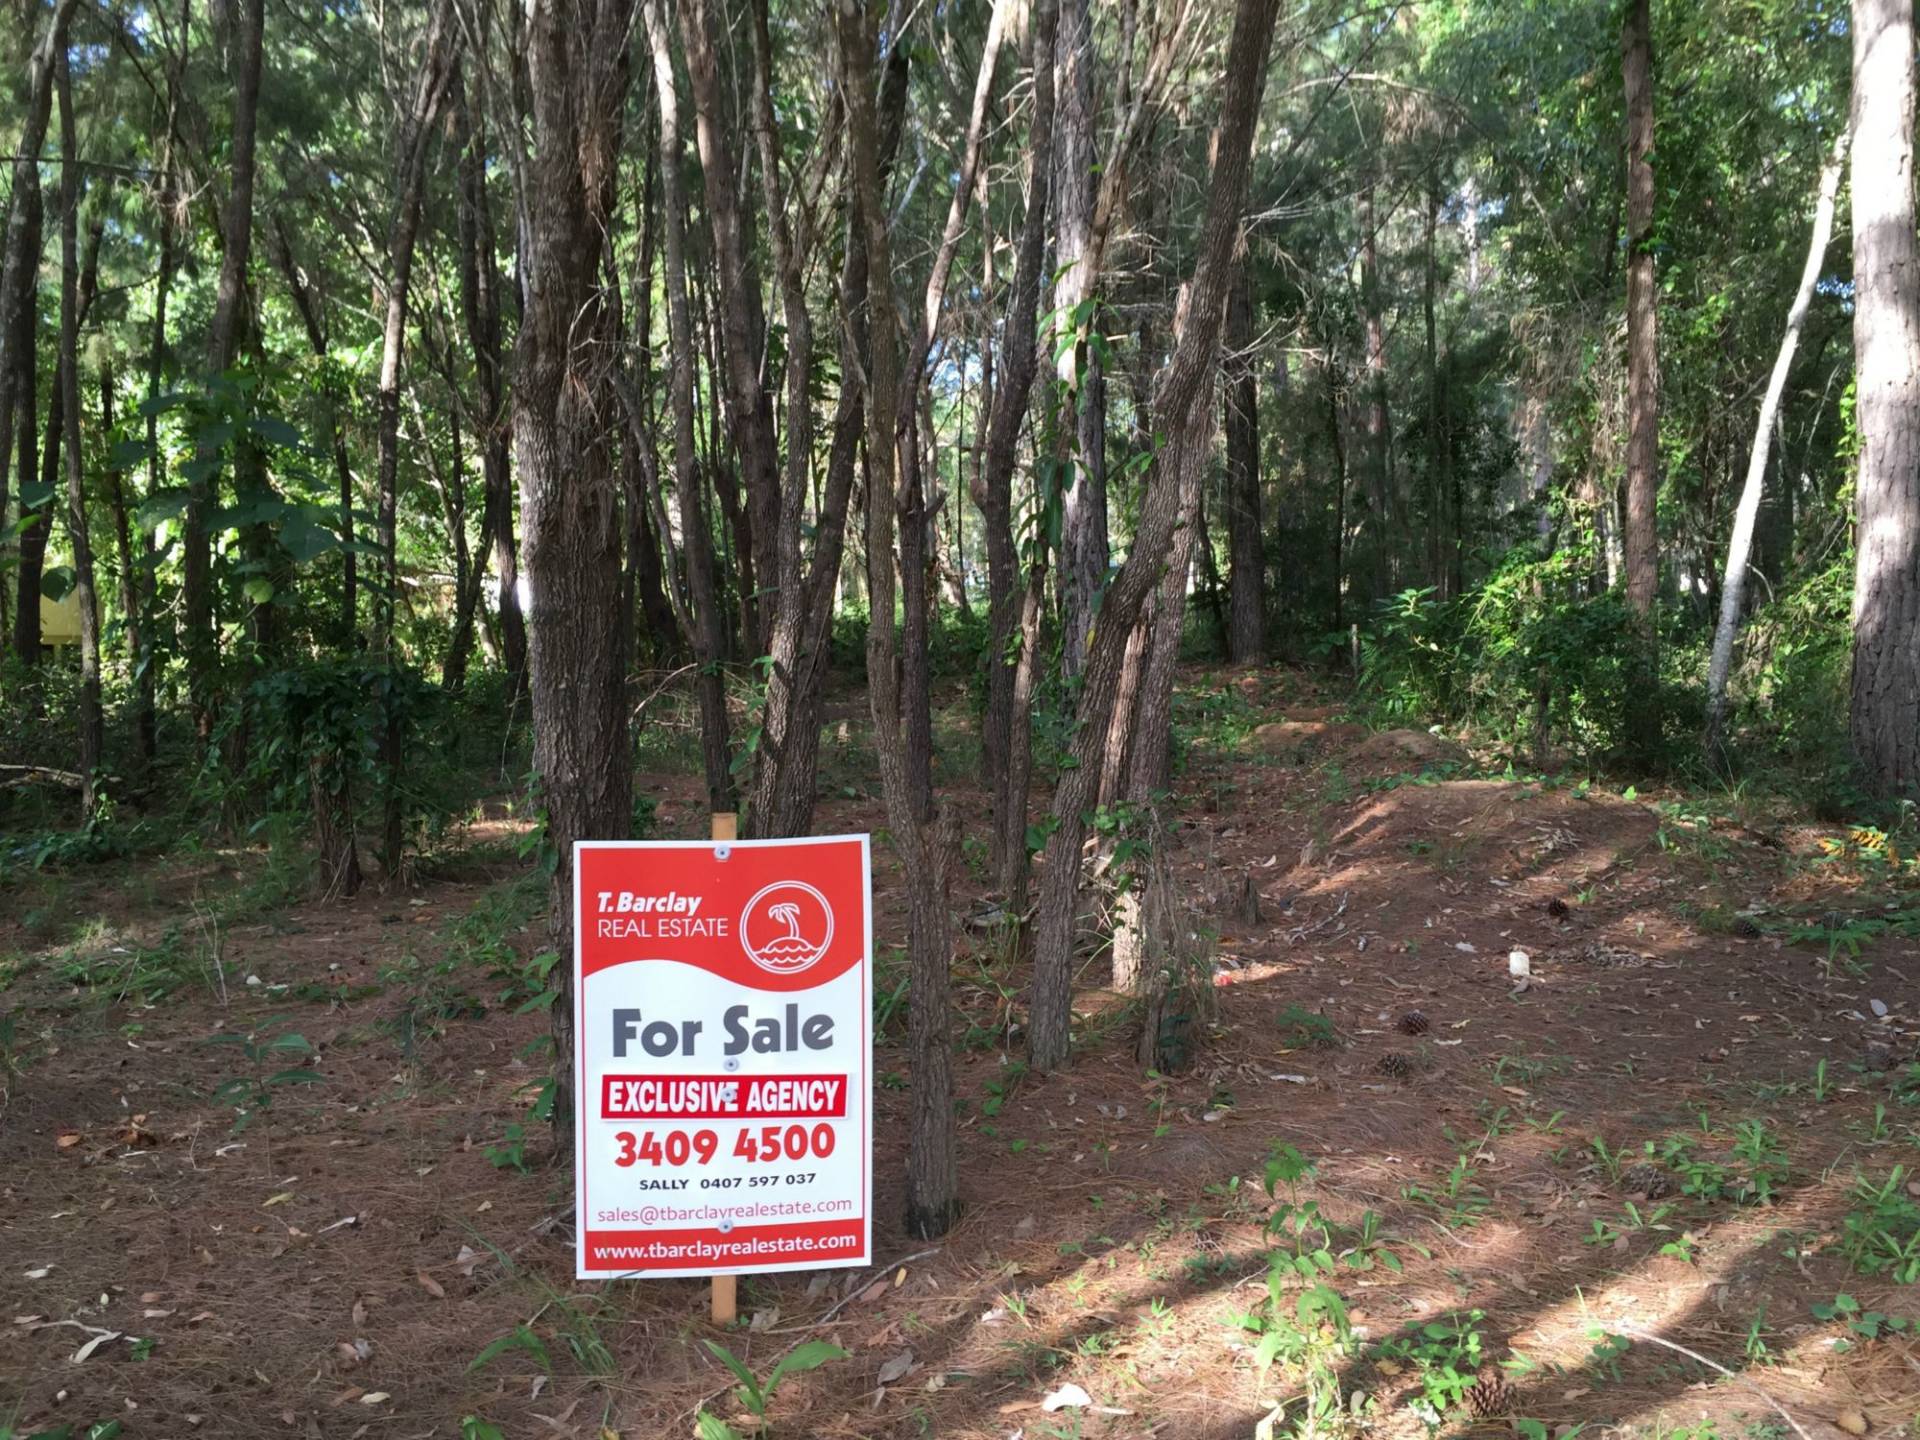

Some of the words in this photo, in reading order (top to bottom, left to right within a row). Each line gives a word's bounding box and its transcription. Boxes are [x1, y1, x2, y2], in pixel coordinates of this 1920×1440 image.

[598, 919, 652, 938] REAL
[658, 918, 729, 937] ESTATE
[612, 1008, 703, 1057] For
[723, 1003, 835, 1056] Sale
[608, 1081, 739, 1113] EXCLUSIVE
[746, 1080, 840, 1111] AGENCY
[614, 1129, 718, 1168] 3409
[733, 1122, 836, 1163] 4500
[639, 1179, 689, 1191] SALLY
[700, 1177, 742, 1189] 0407
[749, 1175, 779, 1188] 597
[785, 1173, 817, 1185] 037
[597, 1200, 853, 1226] sales@tbarclayrealestate.com
[594, 1234, 856, 1261] www.tbarclayrealestate.com
